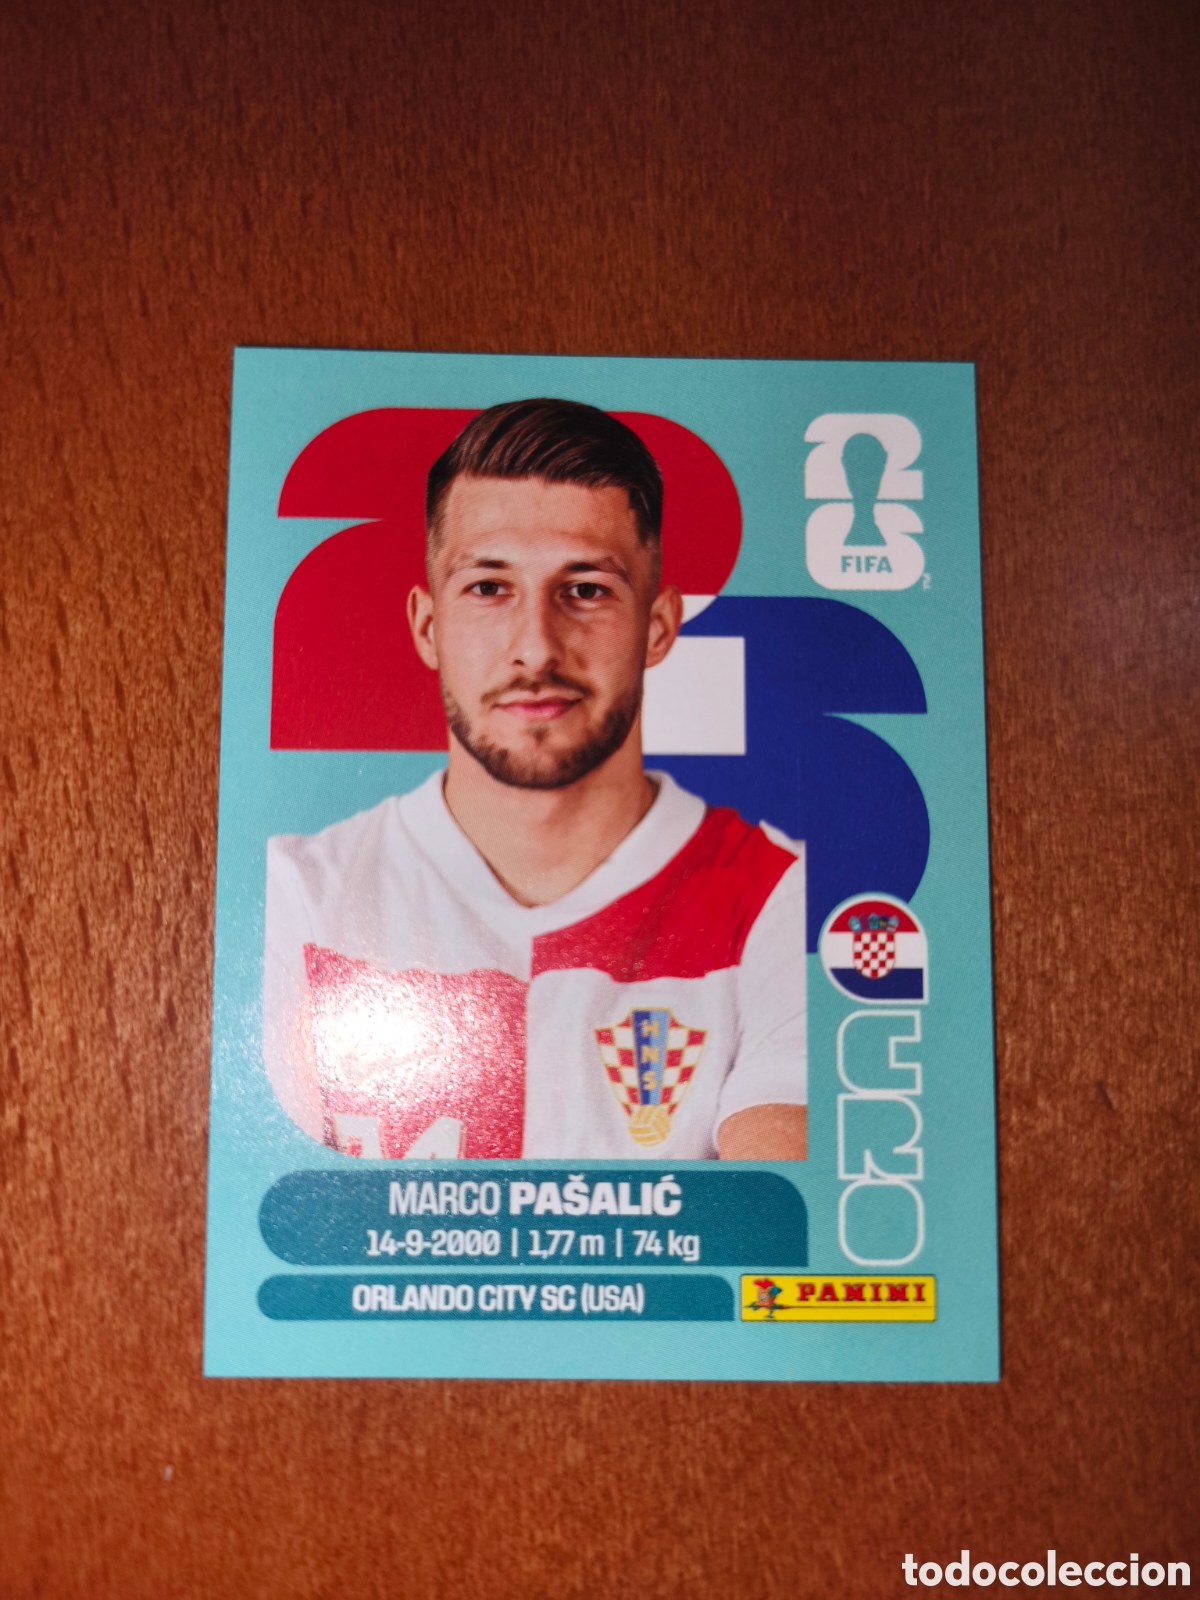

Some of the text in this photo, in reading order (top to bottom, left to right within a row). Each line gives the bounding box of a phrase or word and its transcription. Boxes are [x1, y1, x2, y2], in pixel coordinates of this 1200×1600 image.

[841, 556, 893, 573] FIFA
[641, 1019, 660, 1090] HNS
[837, 1010, 924, 1266] CRO
[389, 1174, 682, 1216] MARCO PAŠALIĆ
[366, 1229, 500, 1256] 14-9-2000
[528, 1229, 575, 1259] 1,77
[580, 1234, 605, 1255] m
[631, 1230, 663, 1256] 74
[668, 1230, 700, 1261] kg
[352, 1282, 645, 1313] ORLANDO CITY SC (USA)
[797, 1283, 926, 1303] PANINI
